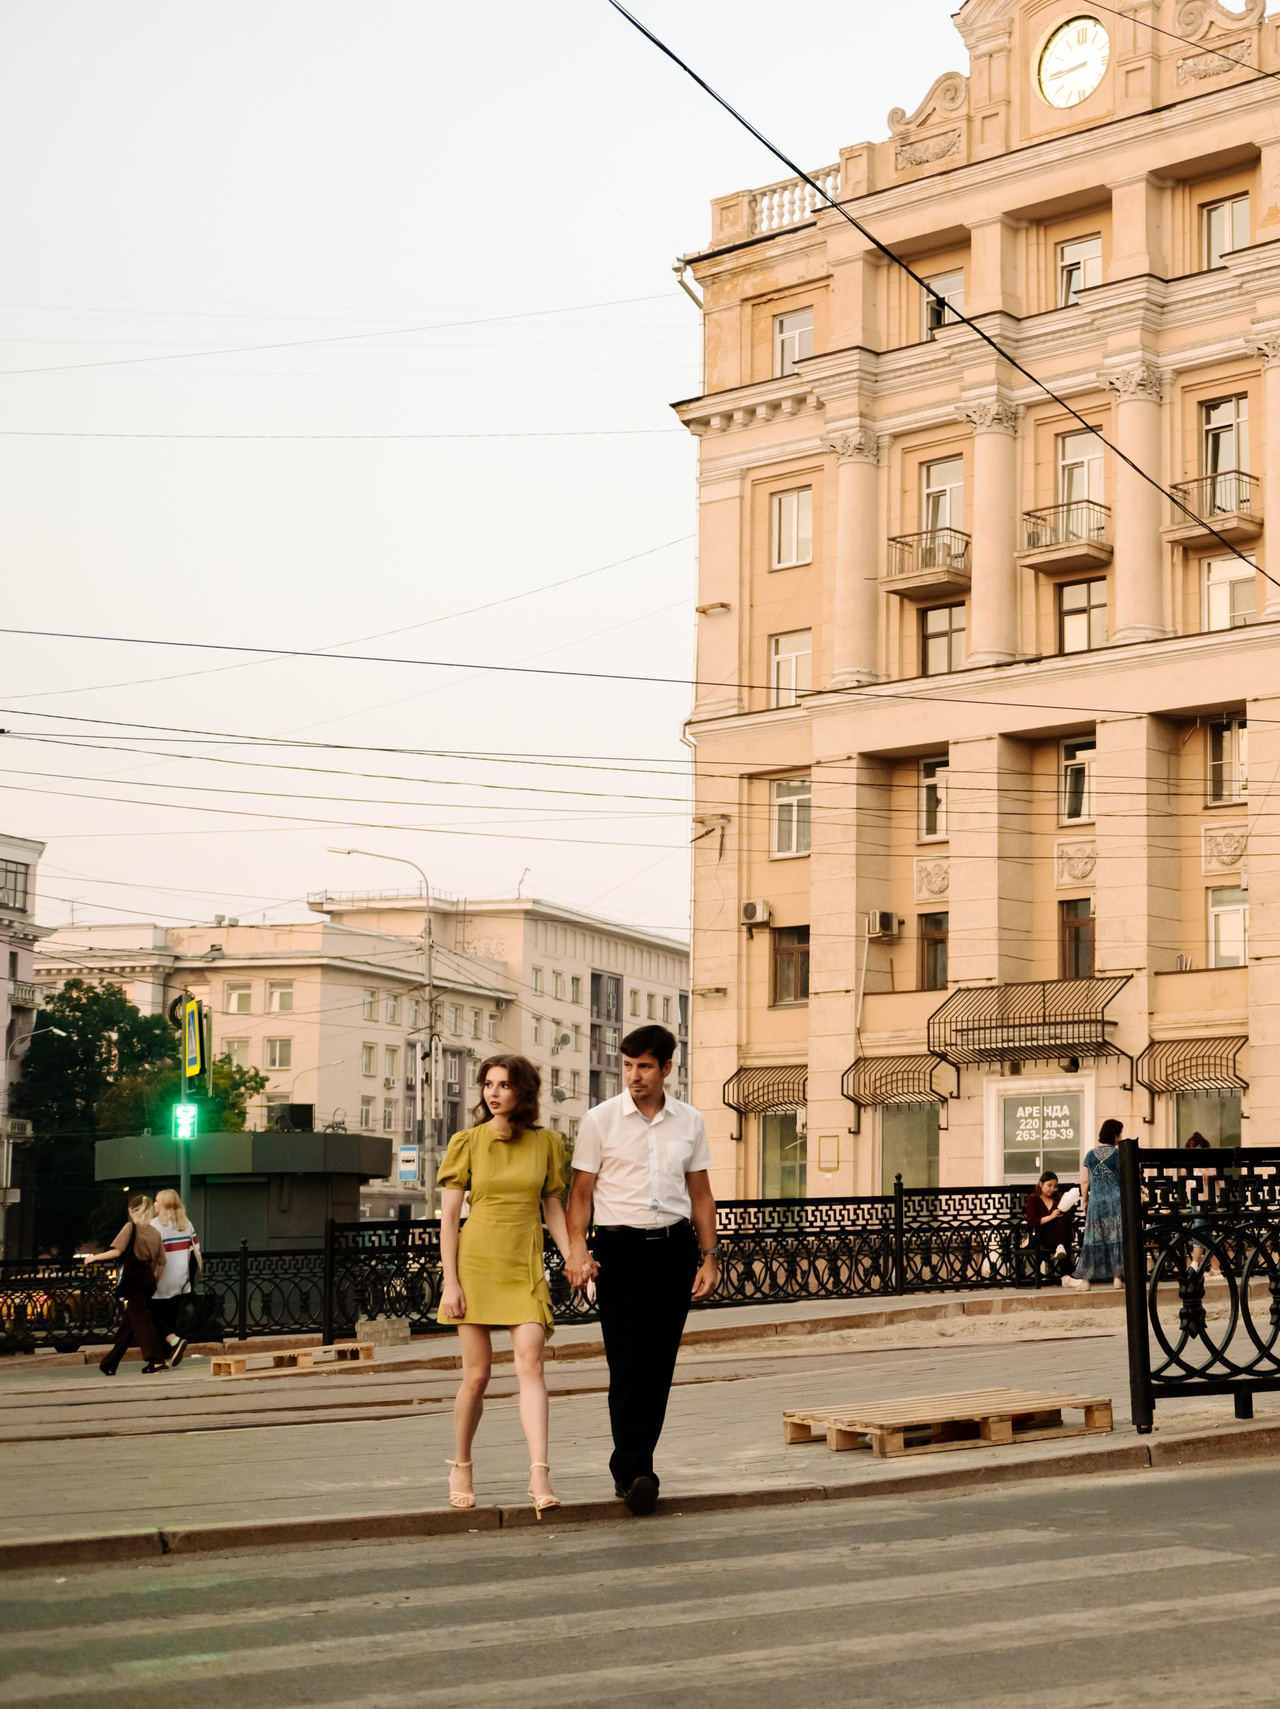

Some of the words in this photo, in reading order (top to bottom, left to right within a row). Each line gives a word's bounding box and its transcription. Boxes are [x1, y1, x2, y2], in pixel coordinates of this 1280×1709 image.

[1016, 1105, 1070, 1118] АРЕНДА
[1020, 1119, 1039, 1129] 220
[1045, 1120, 1070, 1128] кв.м
[1016, 1129, 1074, 1141] 263-29-39
